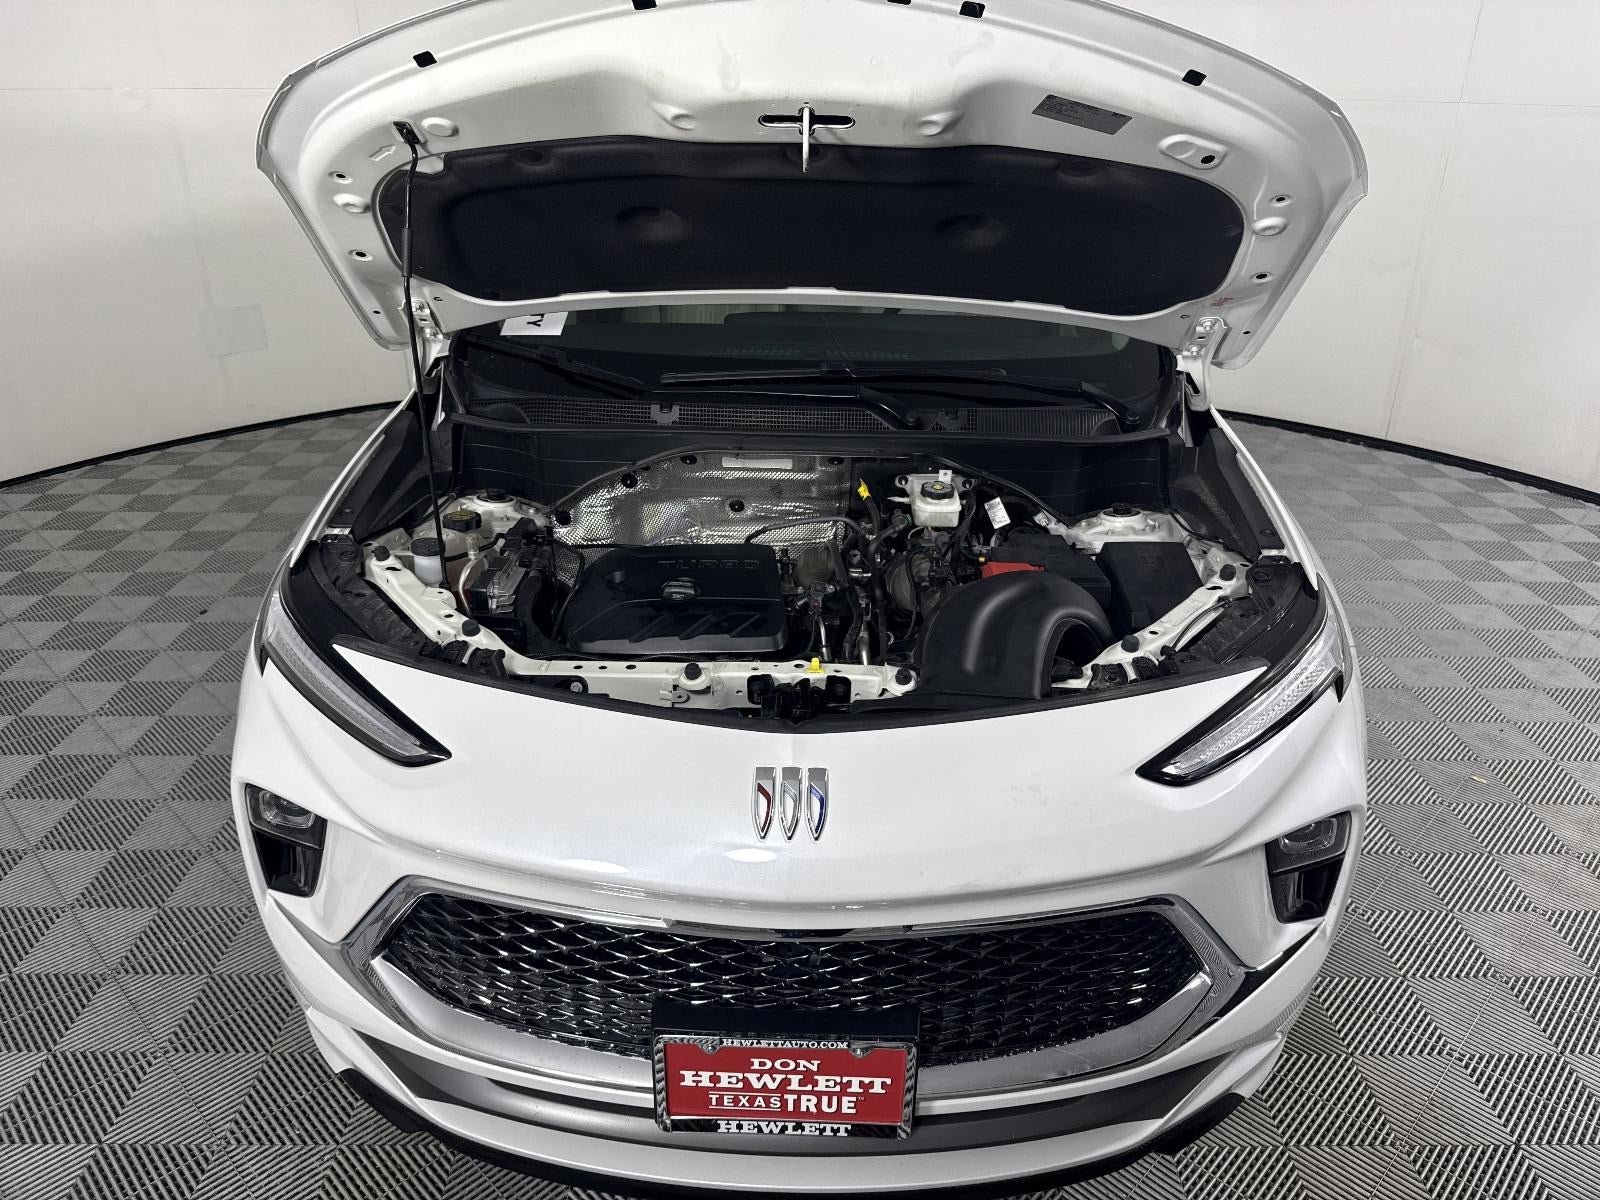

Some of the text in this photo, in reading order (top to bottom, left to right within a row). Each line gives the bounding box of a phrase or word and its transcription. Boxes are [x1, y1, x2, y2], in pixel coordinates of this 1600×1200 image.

[658, 560, 760, 569] TURBO
[722, 1038, 849, 1049] HEWLETTAUTO.COM
[750, 1058, 821, 1072] DON
[680, 1070, 892, 1093] HEWLETT
[717, 1120, 851, 1136] HEWLETT
